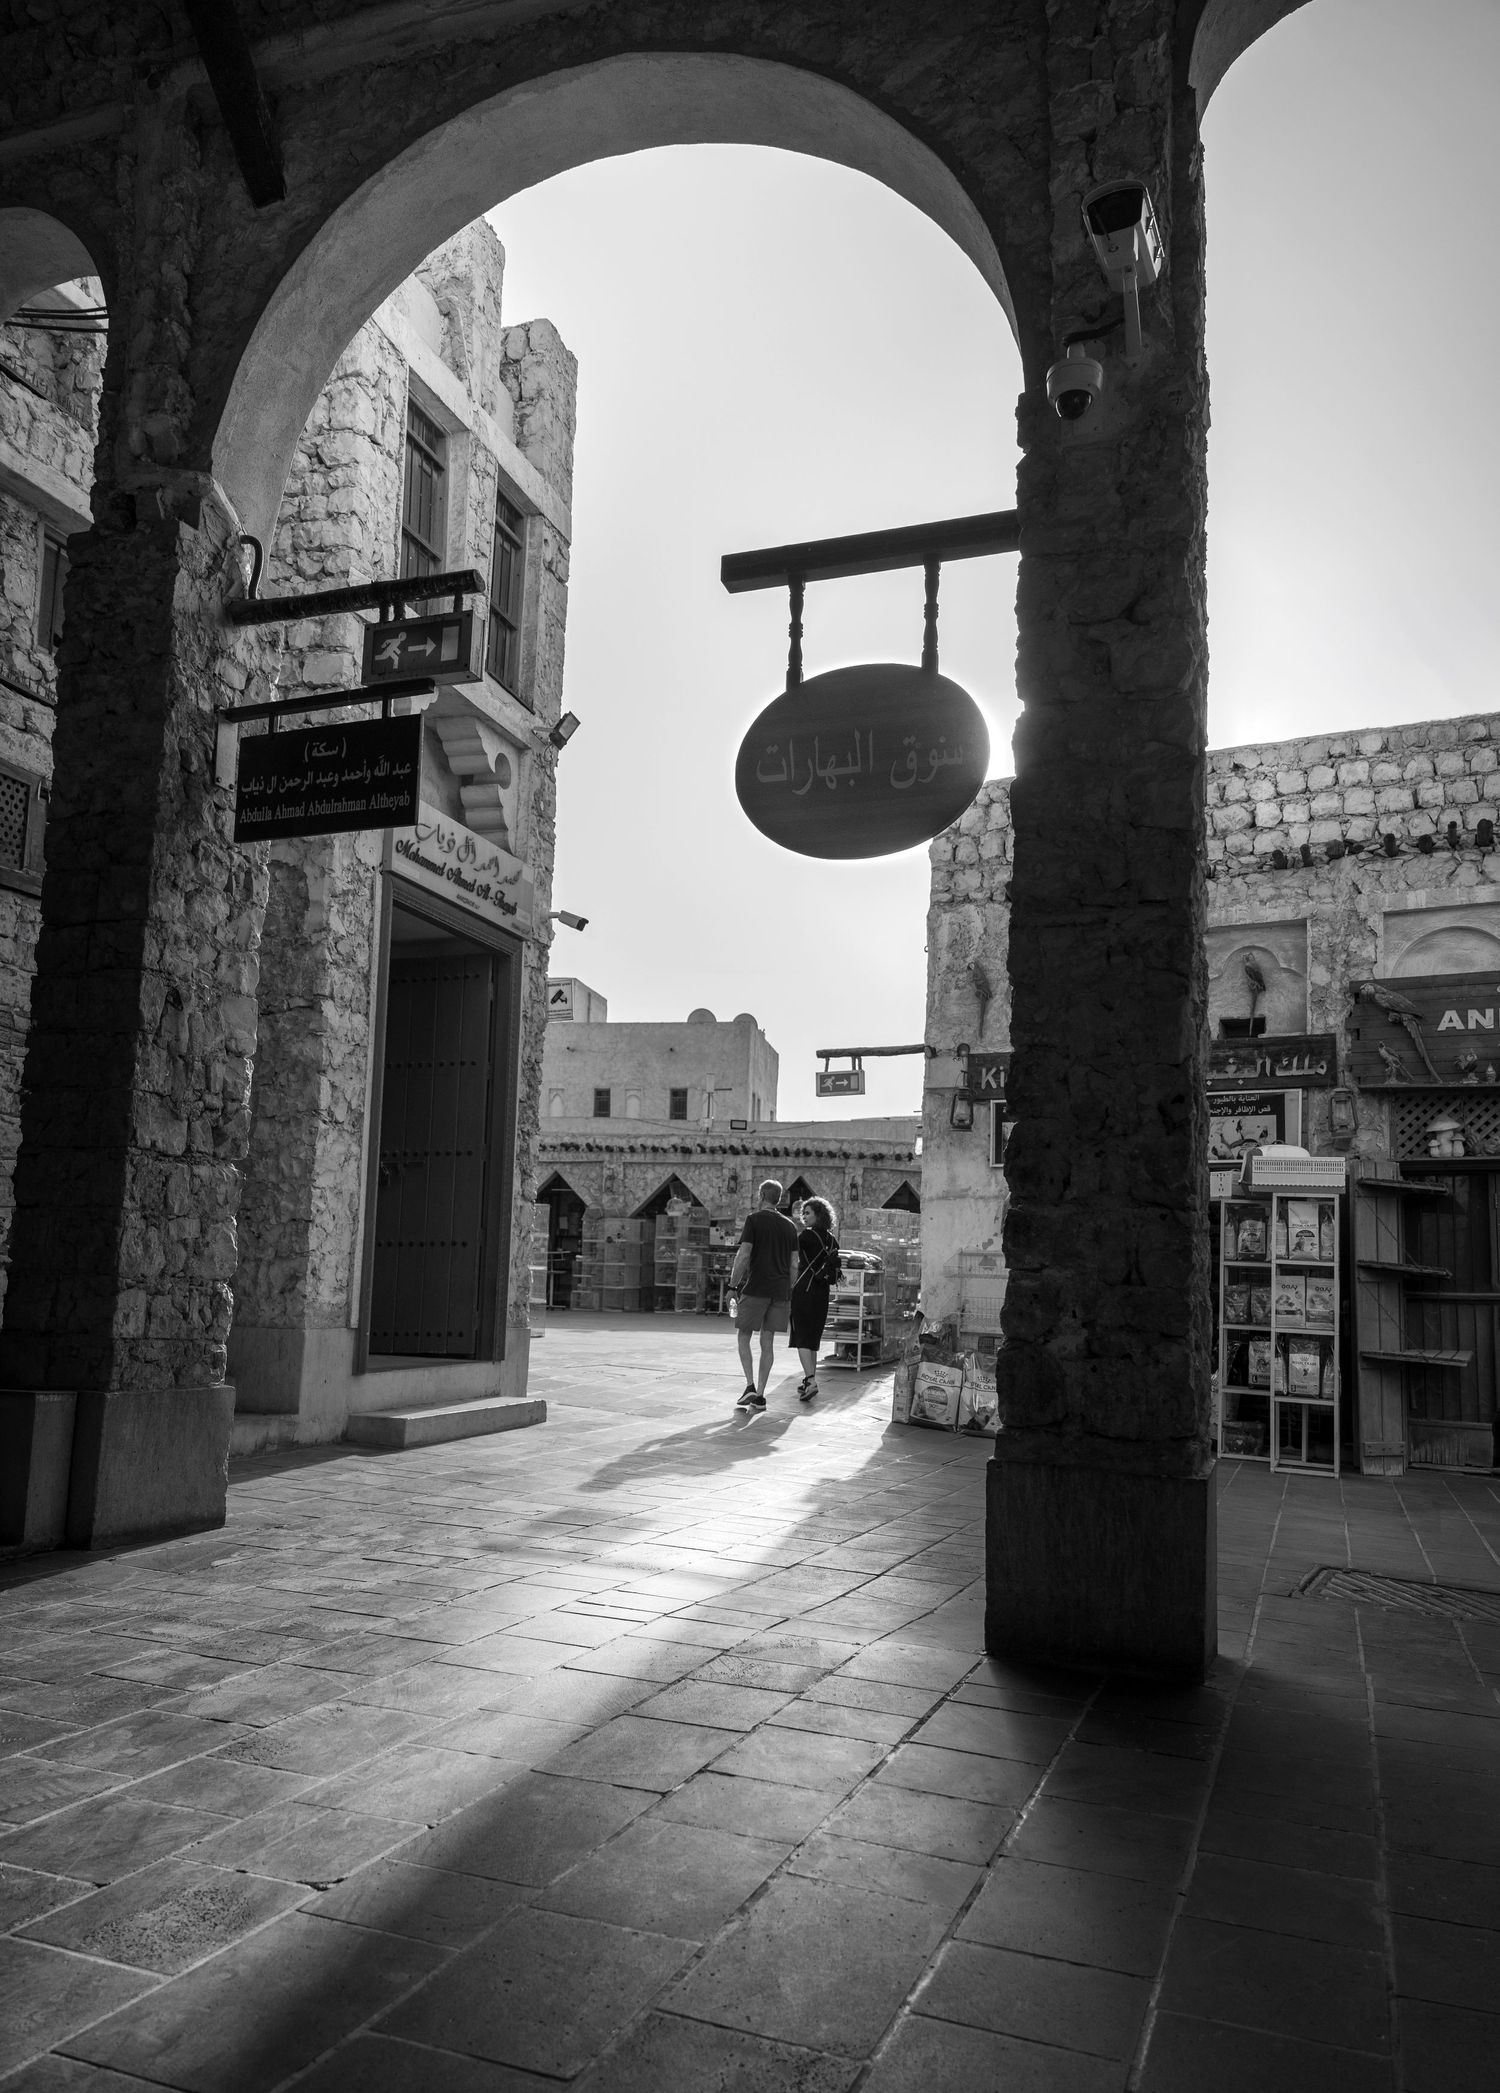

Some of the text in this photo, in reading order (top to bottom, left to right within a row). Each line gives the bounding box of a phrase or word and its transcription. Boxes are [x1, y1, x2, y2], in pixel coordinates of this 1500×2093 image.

[341, 758, 371, 784] وأحمد
[392, 760, 412, 780] عبد
[756, 728, 874, 795] البهارات
[241, 776, 265, 799] ذياب
[279, 771, 314, 793] الرحمن
[316, 769, 339, 788] وعبد
[240, 790, 410, 824] Abdulla Ahmad Abdulrahman Altheyab
[1437, 1008, 1500, 1031] AN
[1275, 1053, 1327, 1077] ملك
[981, 1066, 1007, 1090] Ki
